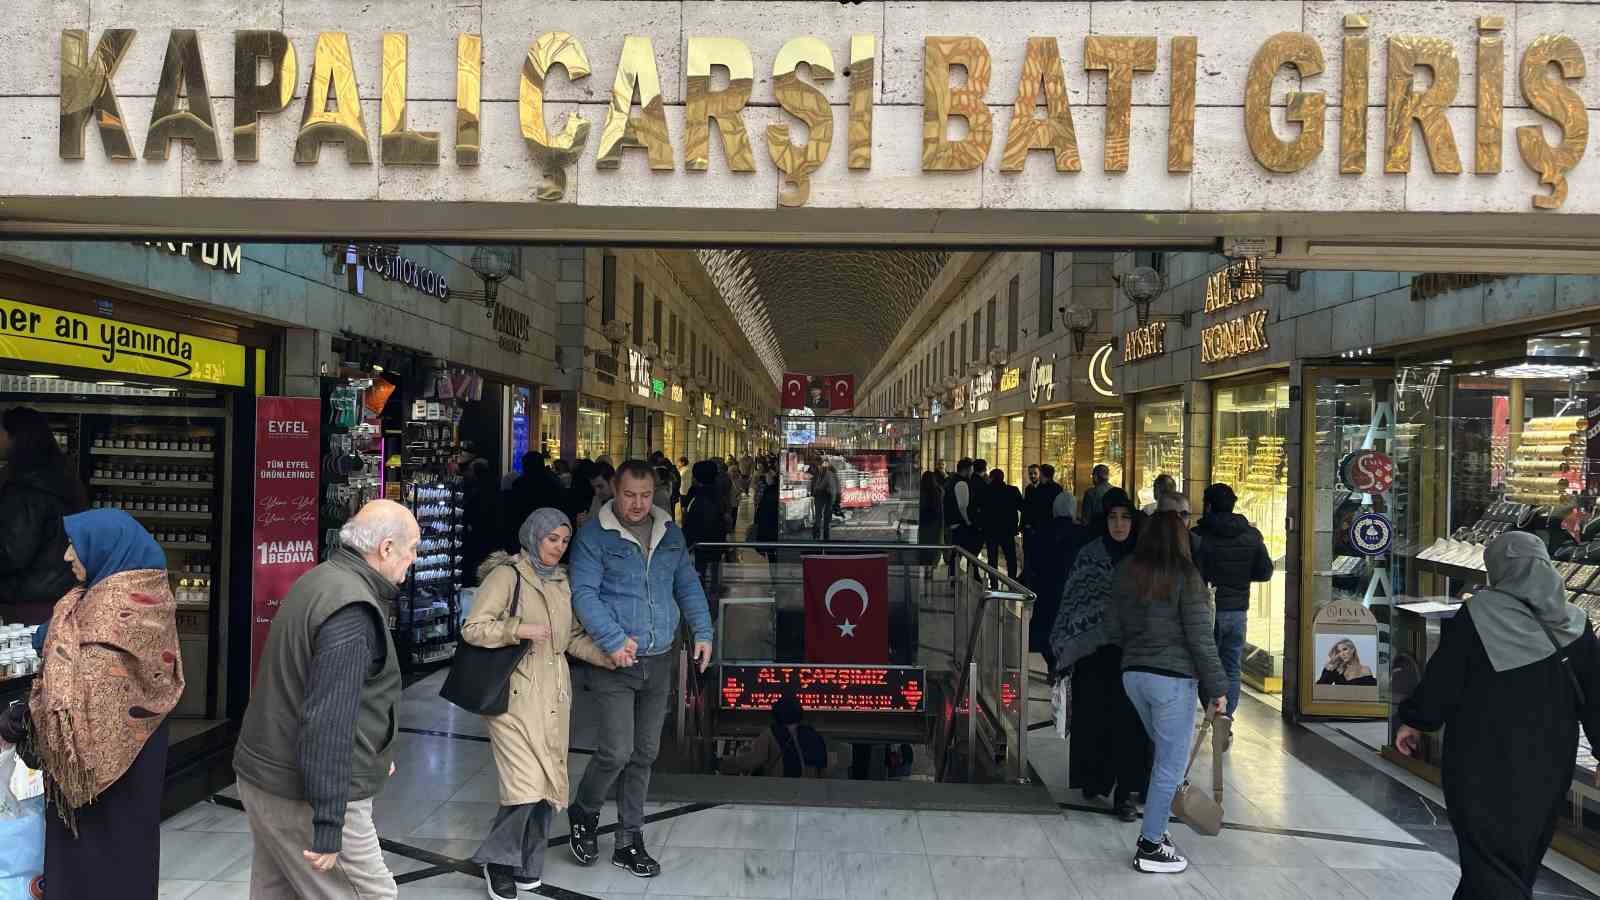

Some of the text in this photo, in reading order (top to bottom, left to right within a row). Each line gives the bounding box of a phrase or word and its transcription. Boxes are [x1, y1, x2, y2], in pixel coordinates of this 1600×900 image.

[59, 15, 1588, 209] KAPALI ÇARŞI BATI GİRİŞ
[56, 315, 89, 341] an
[100, 322, 193, 363] yanında
[1200, 311, 1267, 363] KONAK
[268, 420, 309, 433] EYFEL
[260, 470, 316, 479] ÜRÜNLERİNDE
[266, 460, 309, 469] TÜM EYFEL
[257, 540, 314, 565] 1 ALANA
[268, 552, 315, 564] BEDAVA
[757, 667, 889, 689] ALT ÇARŞIMIZ
